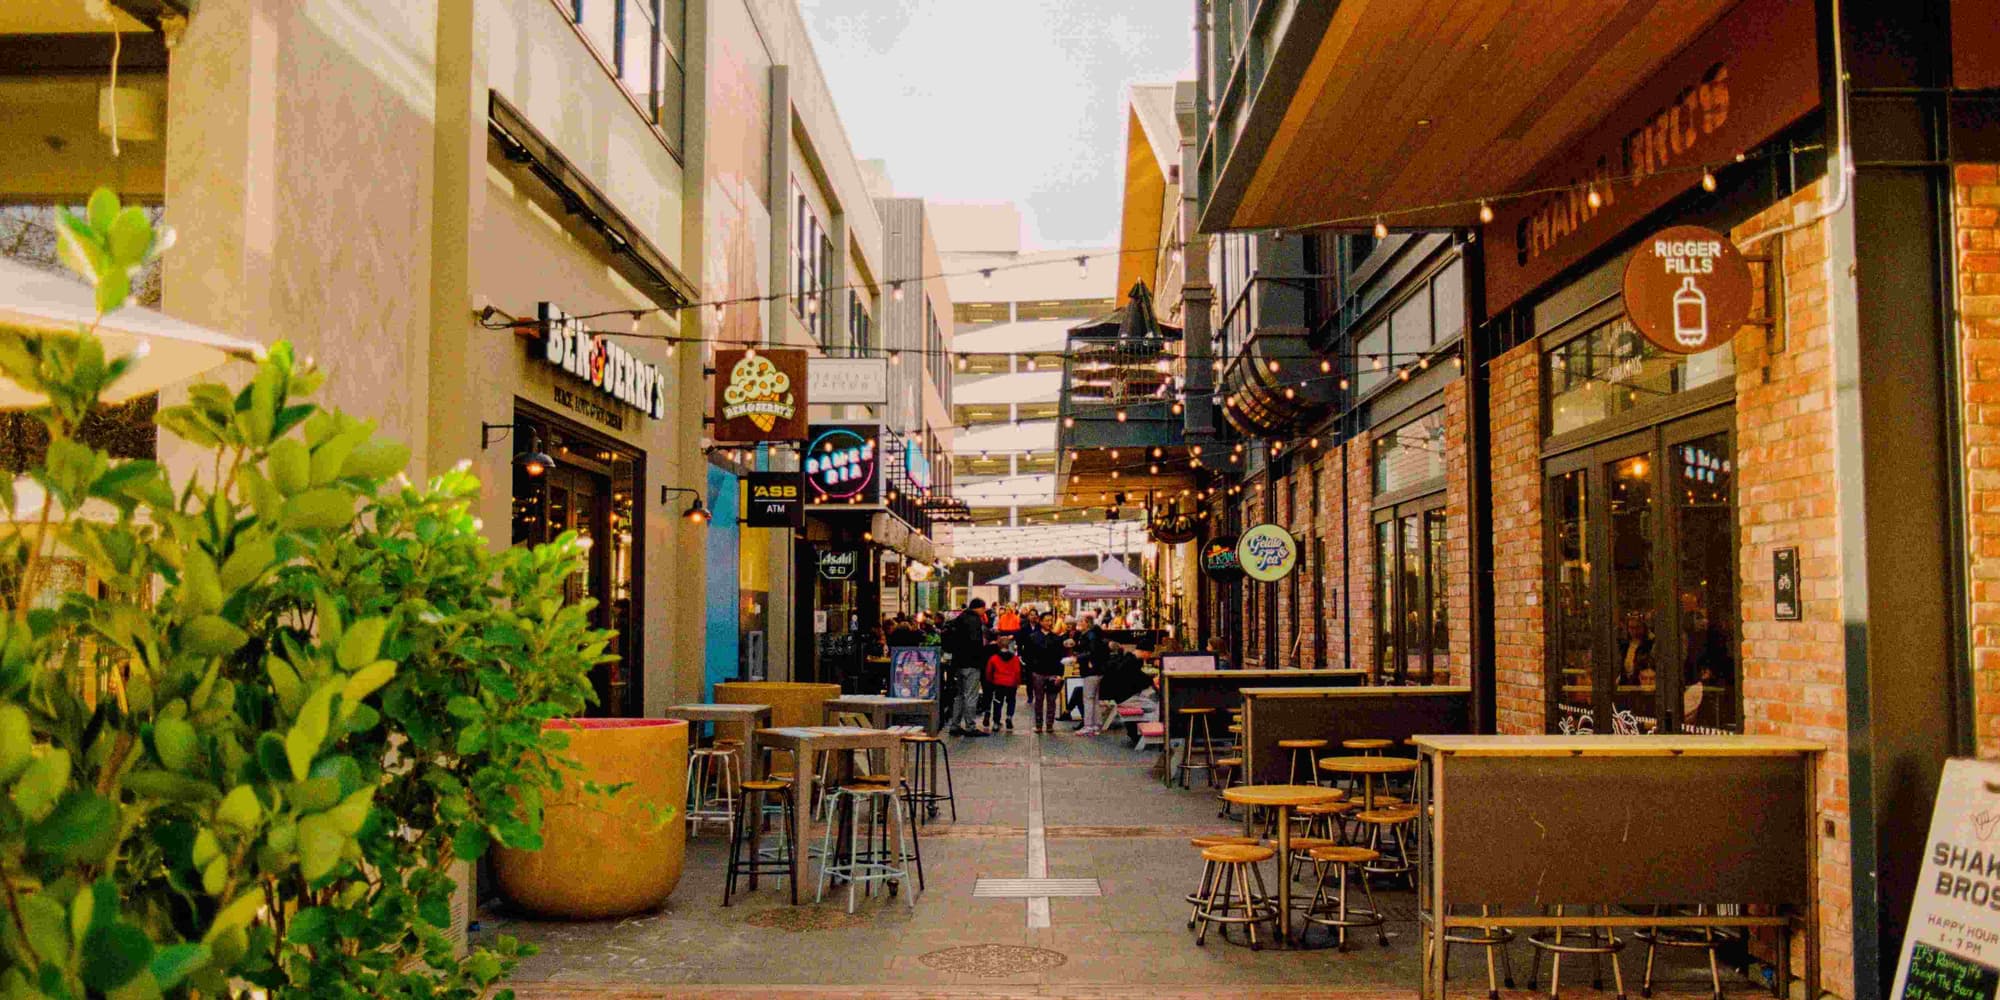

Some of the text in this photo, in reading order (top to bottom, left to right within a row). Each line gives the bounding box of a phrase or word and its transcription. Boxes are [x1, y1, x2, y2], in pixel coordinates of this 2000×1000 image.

[1655, 240, 1721, 257] RIGGER
[1665, 258, 1713, 273] FILLS
[755, 485, 797, 497] ASB
[766, 504, 785, 513] ATM
[1248, 535, 1282, 555] Gelato
[822, 552, 852, 565] Asahi
[1258, 549, 1281, 571] Tea
[1935, 871, 2000, 911] BROS
[1928, 914, 1999, 945] HAPPY HOUR
[1966, 941, 1983, 956] PM
